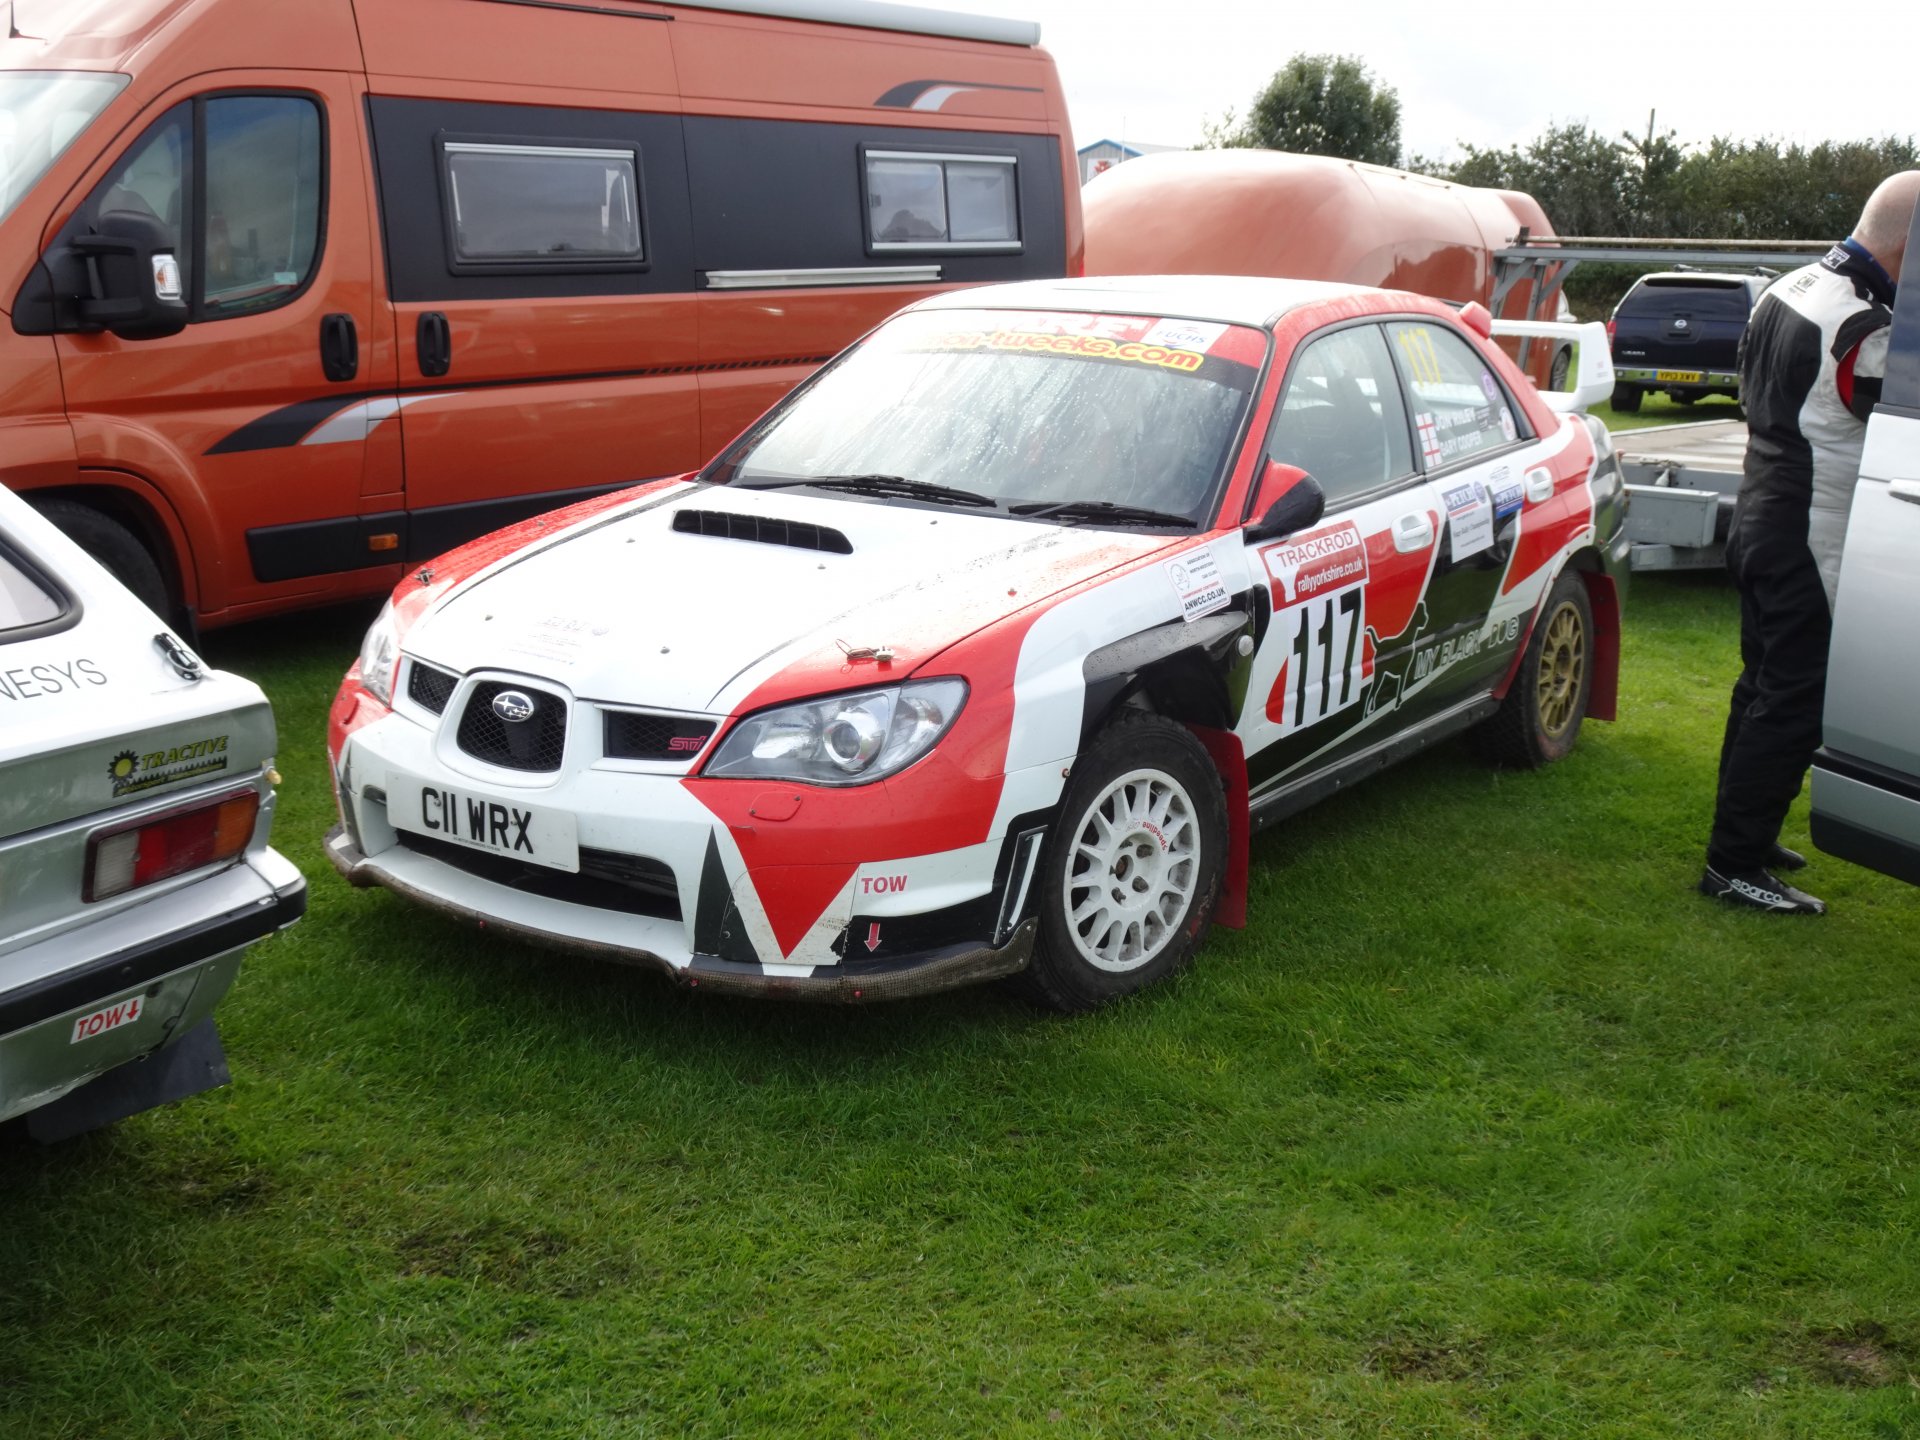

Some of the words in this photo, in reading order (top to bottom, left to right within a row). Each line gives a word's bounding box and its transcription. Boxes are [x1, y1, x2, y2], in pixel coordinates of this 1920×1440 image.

[1398, 327, 1442, 389] 117
[1440, 438, 1458, 457] GARY
[1276, 531, 1354, 568] TRACKROD
[1297, 556, 1364, 593] rallyyorkshire.co.uk
[1184, 587, 1226, 611] ANWCC.CO.UK
[1293, 586, 1362, 728] 117
[1414, 644, 1441, 681] MY
[1441, 629, 1481, 667] BLACK
[141, 735, 229, 771] TRACTIVE
[466, 797, 534, 855] WRX
[1142, 821, 1168, 851] speedline
[861, 875, 908, 894] TOW
[1731, 878, 1783, 903] sparco
[77, 1003, 127, 1040] TOW
